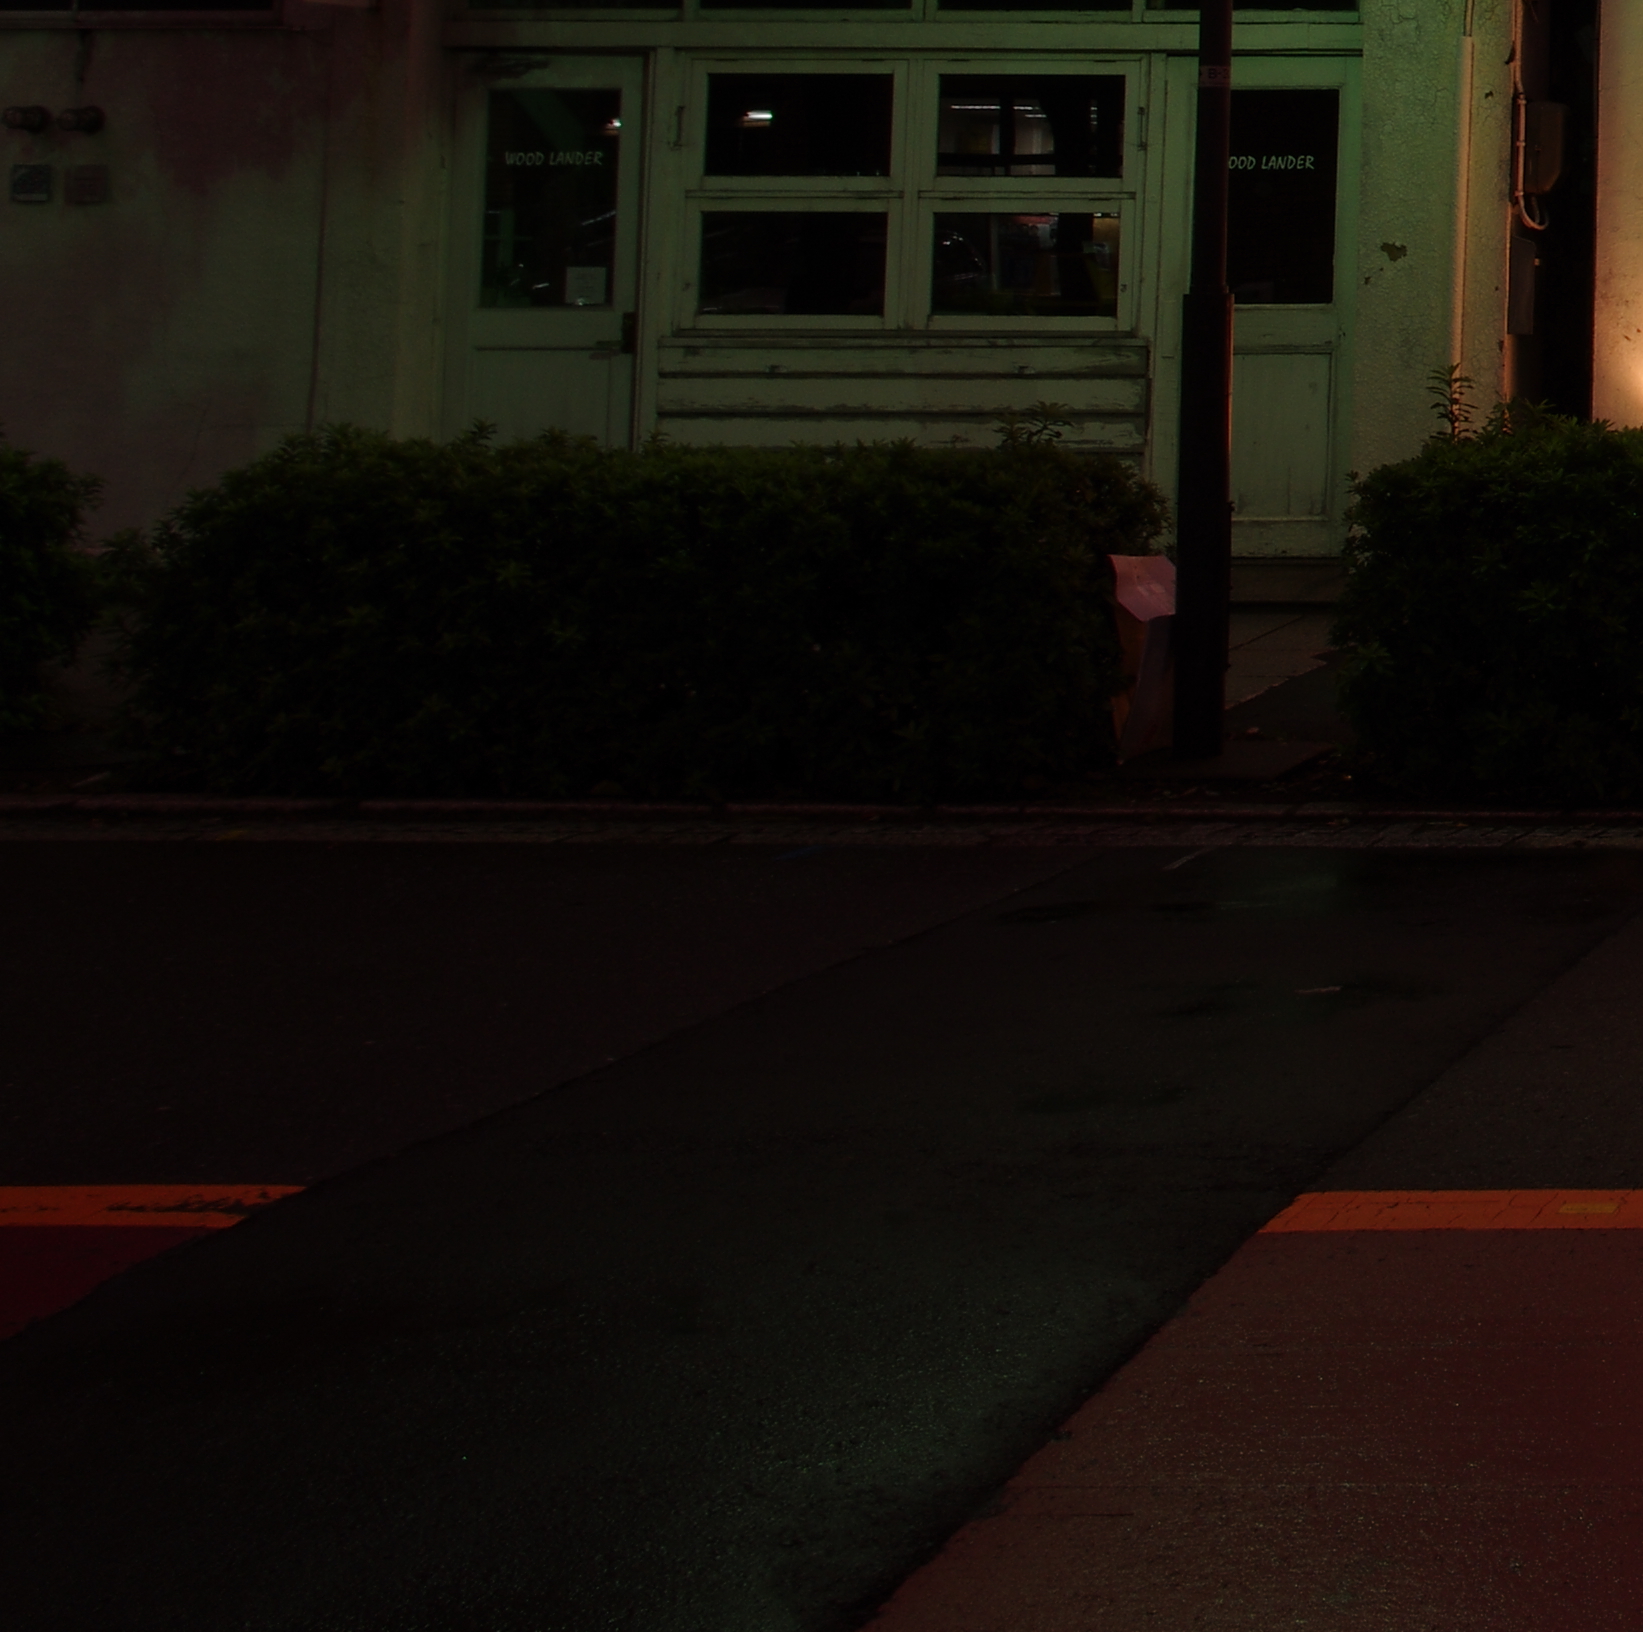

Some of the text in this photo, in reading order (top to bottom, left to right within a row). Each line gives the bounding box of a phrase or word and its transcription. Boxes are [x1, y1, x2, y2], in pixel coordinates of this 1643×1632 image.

[504, 151, 604, 166] WOOD LANDER
[1228, 155, 1315, 170] OOD LANDER
